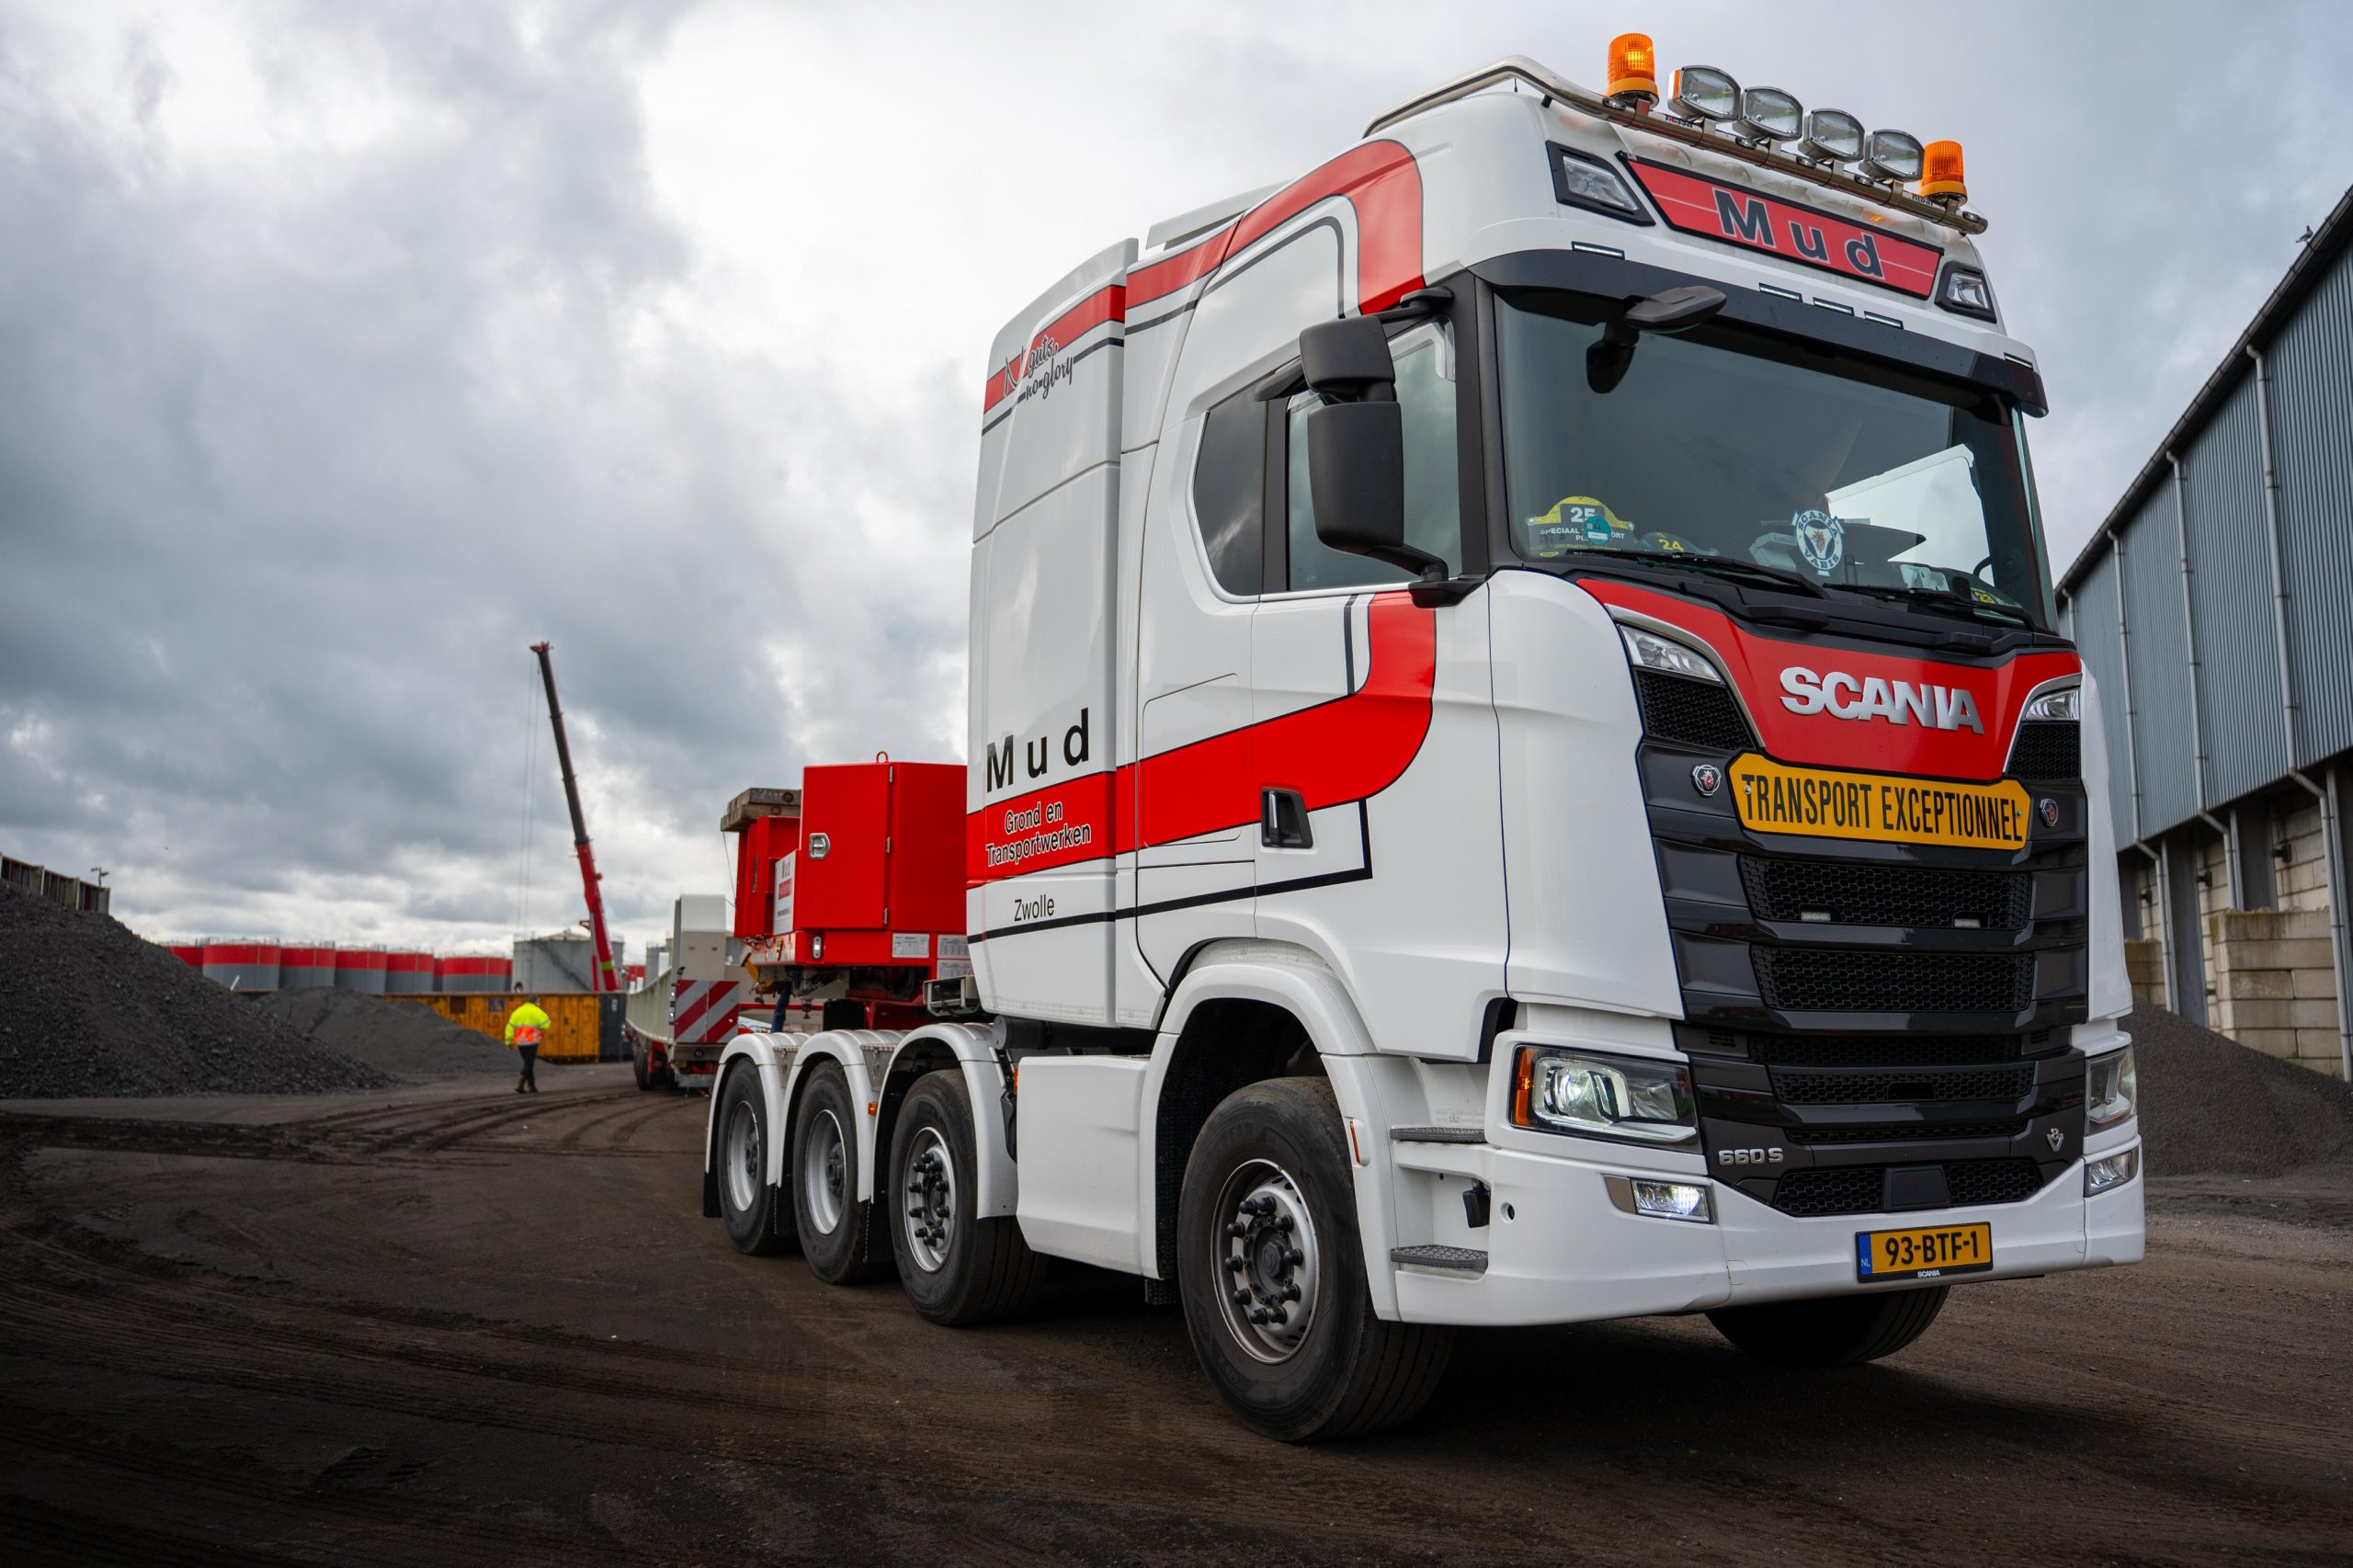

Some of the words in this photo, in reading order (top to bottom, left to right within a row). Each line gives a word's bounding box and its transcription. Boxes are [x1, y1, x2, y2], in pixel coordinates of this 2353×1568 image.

[1711, 187, 1886, 280] Mud
[1798, 511, 1839, 539] SCANIA
[1658, 538, 1685, 553] 24
[1803, 547, 1839, 568] VABIS
[1779, 665, 1985, 735] SCANIA
[986, 707, 1090, 793] Mud
[1005, 801, 1041, 835] Grond
[1045, 801, 1063, 824] en
[1741, 774, 1872, 830] TRANSPORT
[1881, 786, 2023, 842] EXCEPTIONNEL
[985, 823, 1091, 868] Transportwerken
[1014, 893, 1055, 922] Zwolle
[1718, 1148, 1766, 1166] 660
[1768, 1147, 1784, 1164] S
[1860, 1257, 1871, 1267] NL
[1885, 1231, 1979, 1267] 93-BTF-1
[1916, 1269, 1941, 1278] SCANIA
